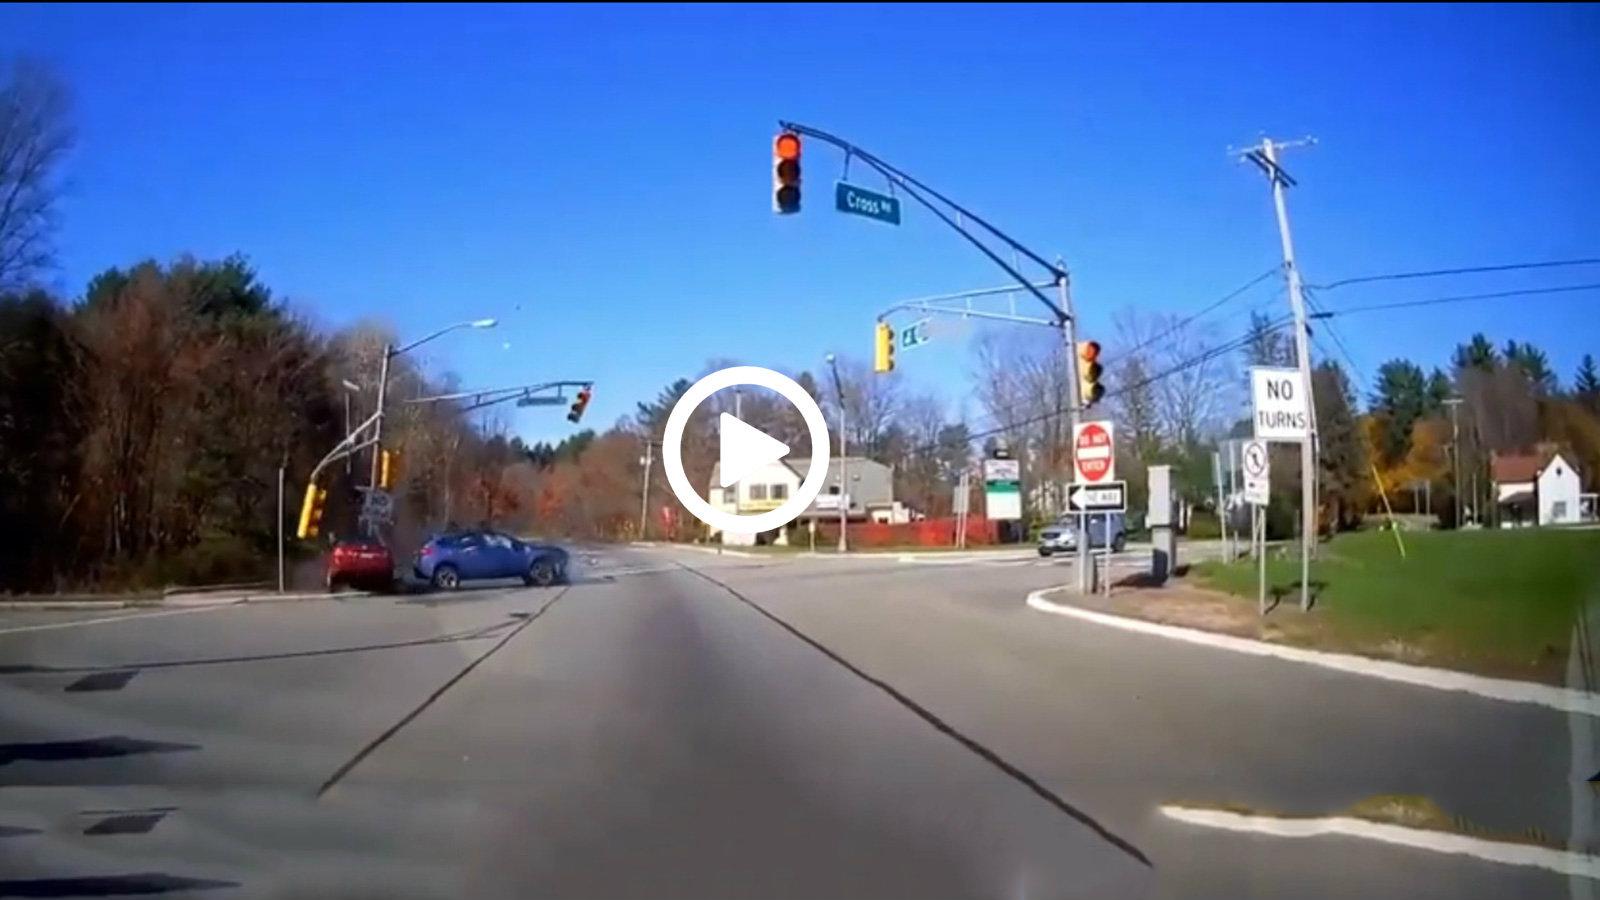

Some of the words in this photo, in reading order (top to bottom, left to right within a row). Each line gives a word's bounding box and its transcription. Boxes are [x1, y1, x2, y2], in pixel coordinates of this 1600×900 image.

[846, 190, 880, 215] Cross
[1267, 379, 1293, 401] NO
[1259, 410, 1307, 430] TURNS
[1080, 433, 1091, 446] DO
[1093, 431, 1108, 445] NOT
[1081, 460, 1106, 474] ENTER
